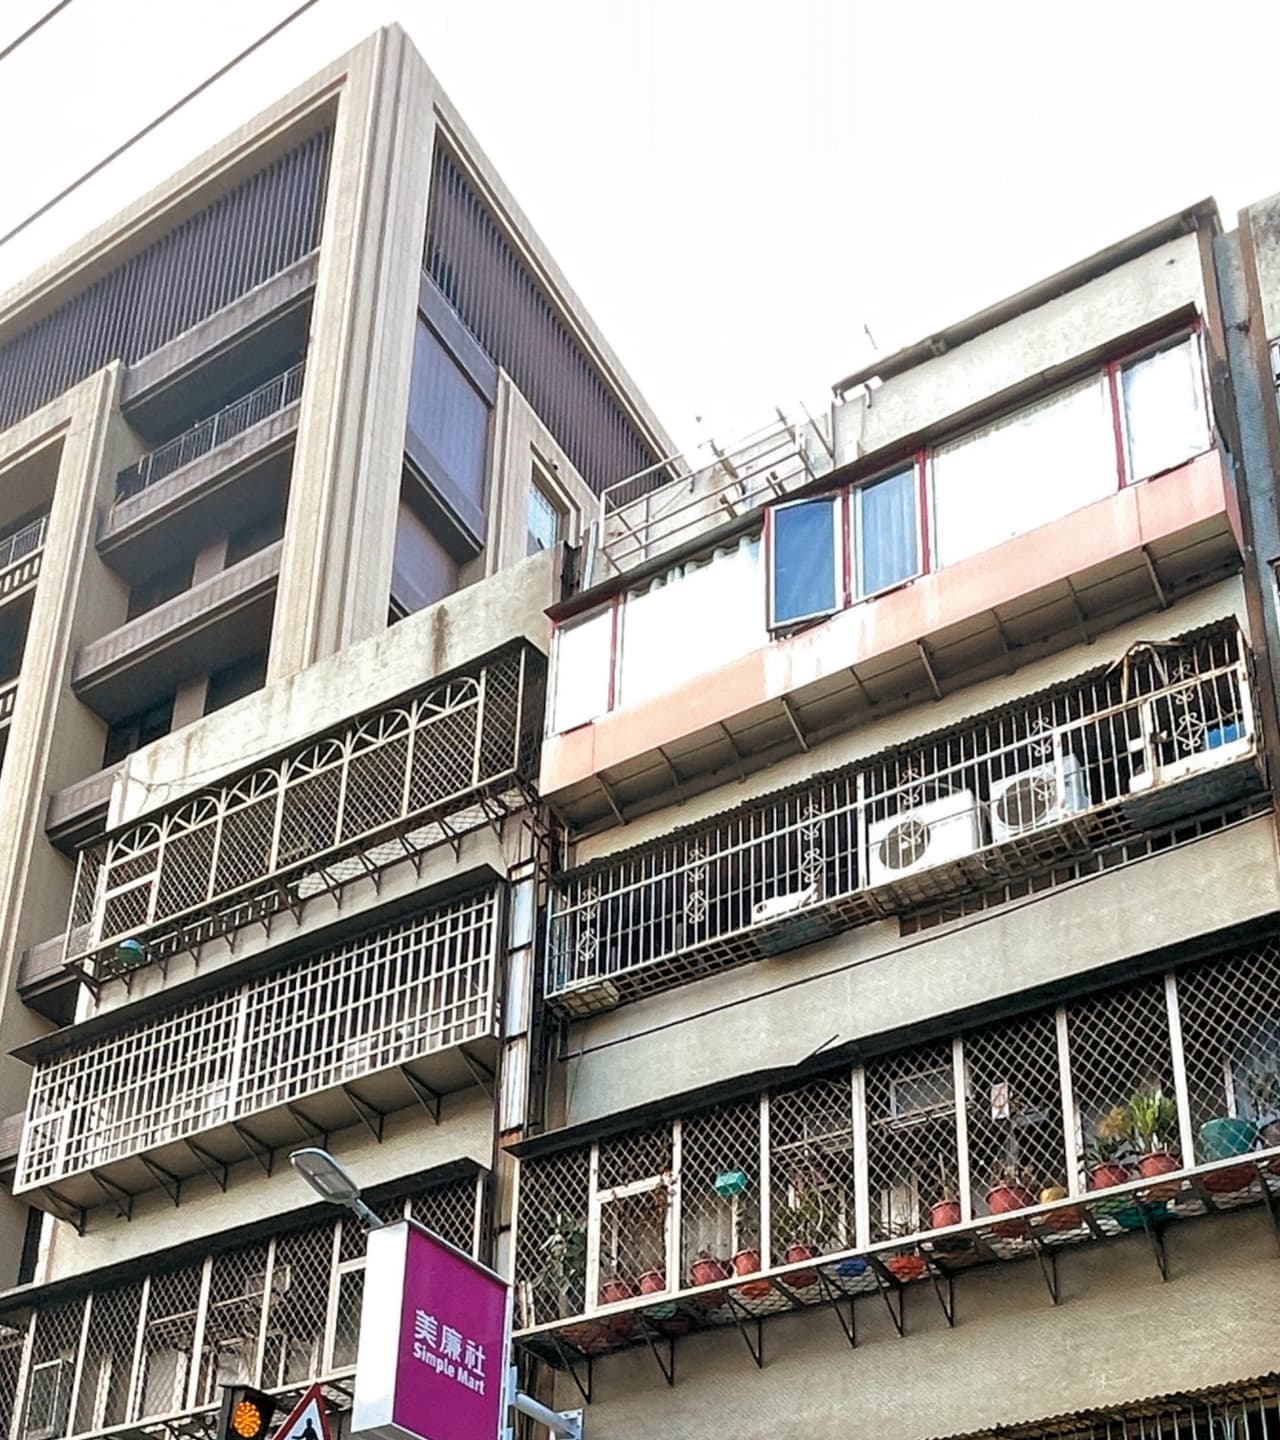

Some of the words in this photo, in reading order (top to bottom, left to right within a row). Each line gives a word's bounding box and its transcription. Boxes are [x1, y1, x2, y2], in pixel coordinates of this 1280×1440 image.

[413, 1341, 455, 1378] Simple
[457, 1366, 485, 1396] Mart
[414, 1309, 486, 1378] 美廉社
